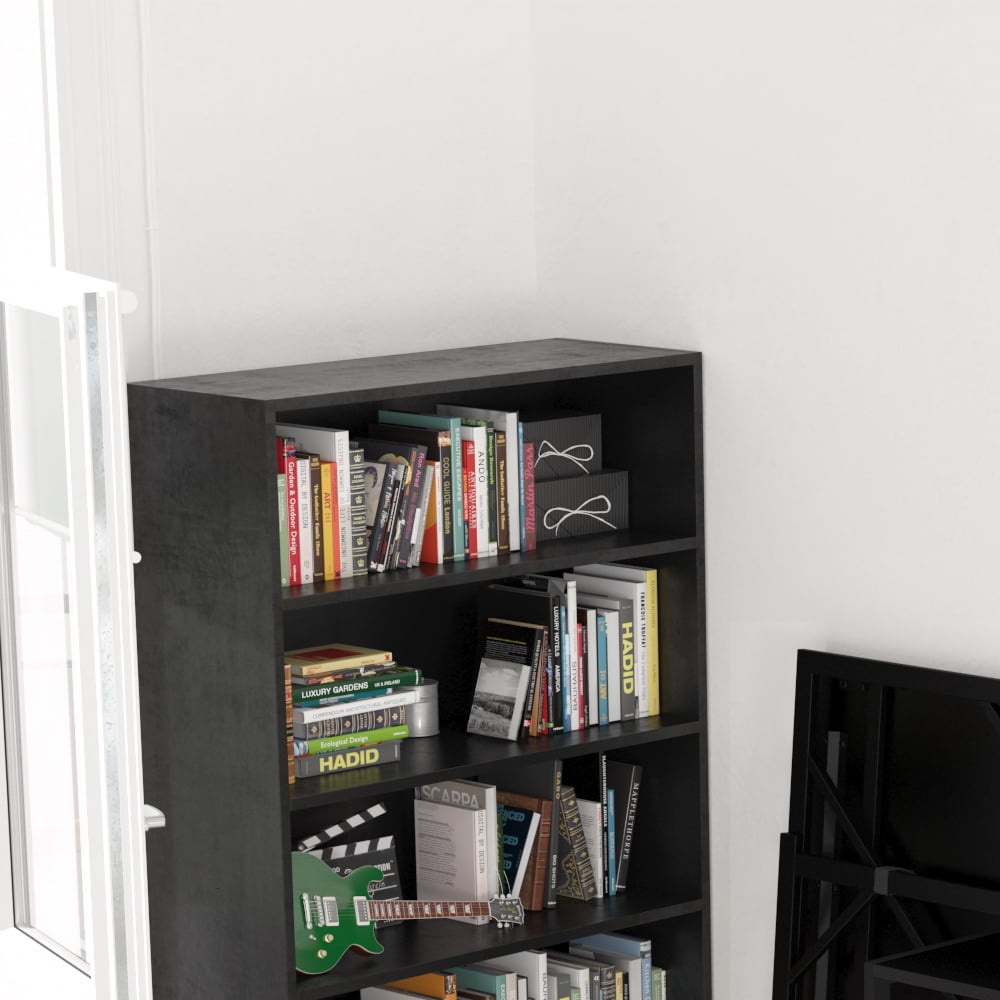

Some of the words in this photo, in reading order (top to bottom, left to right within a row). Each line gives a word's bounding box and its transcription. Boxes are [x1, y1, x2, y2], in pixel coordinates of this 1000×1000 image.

[417, 452, 425, 468] Ron
[414, 469, 422, 488] Arad
[290, 531, 298, 555] Design
[622, 622, 634, 694] HADID
[301, 687, 332, 699] LUXURY
[333, 682, 369, 694] GARDENS
[320, 738, 348, 749] Ecological
[349, 735, 369, 744] Design
[319, 748, 380, 773] HADID
[422, 785, 479, 809] SCARPA
[623, 782, 640, 860] MAPPLETHORPE
